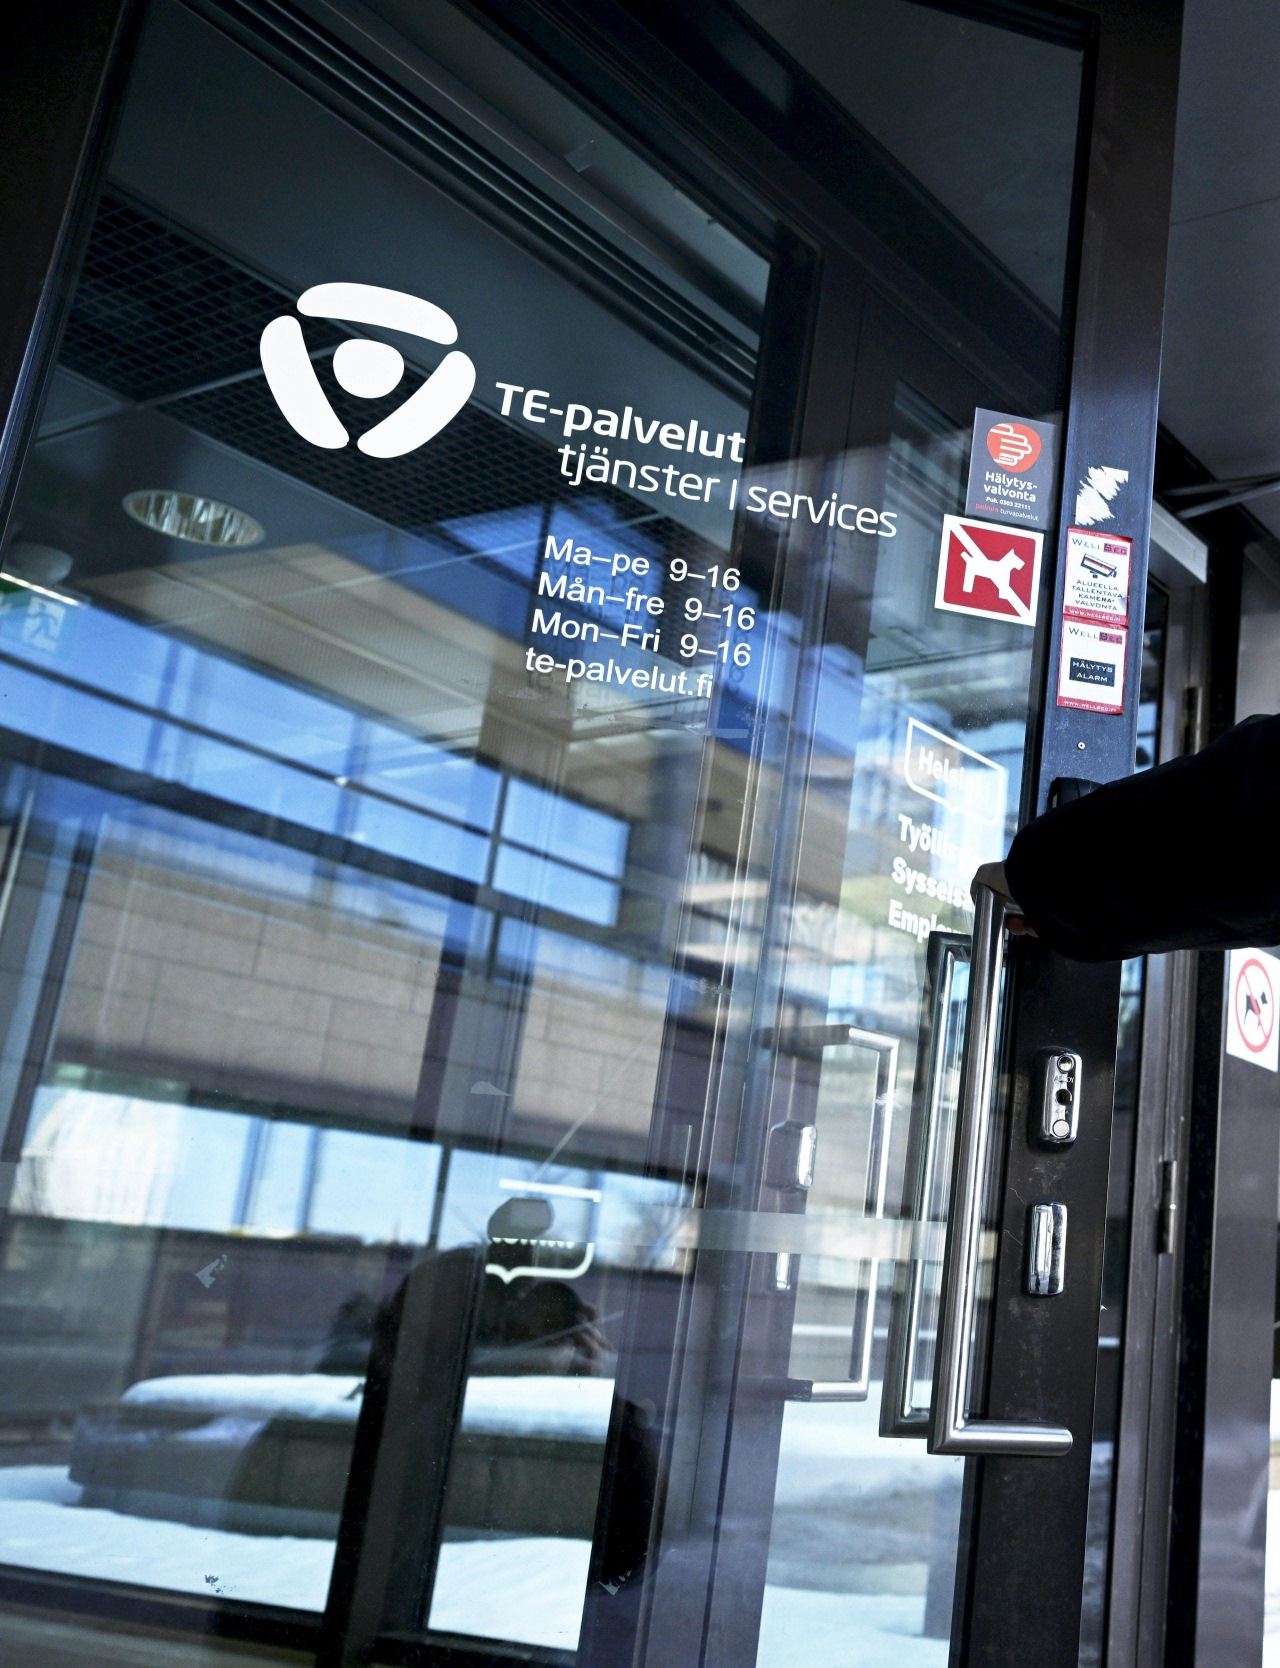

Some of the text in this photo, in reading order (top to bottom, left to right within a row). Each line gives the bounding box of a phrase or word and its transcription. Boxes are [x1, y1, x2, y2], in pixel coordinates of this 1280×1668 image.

[495, 381, 746, 463] TE-palvelut
[985, 471, 1038, 490] Hälytys-
[557, 443, 721, 503] tjänster
[746, 485, 898, 538] services
[983, 483, 1037, 503] valvonta
[985, 496, 999, 504] Puh.
[1000, 508, 1039, 521] turvapalvelut
[1071, 585, 1123, 598] TALLENTAVA
[1076, 579, 1119, 591] ALUEELLA
[1075, 599, 1118, 611] VALVONTA
[525, 646, 714, 699] te-palvelut.fi
[1072, 660, 1113, 673] HÄLYTYS
[1076, 672, 1108, 683] ALARM
